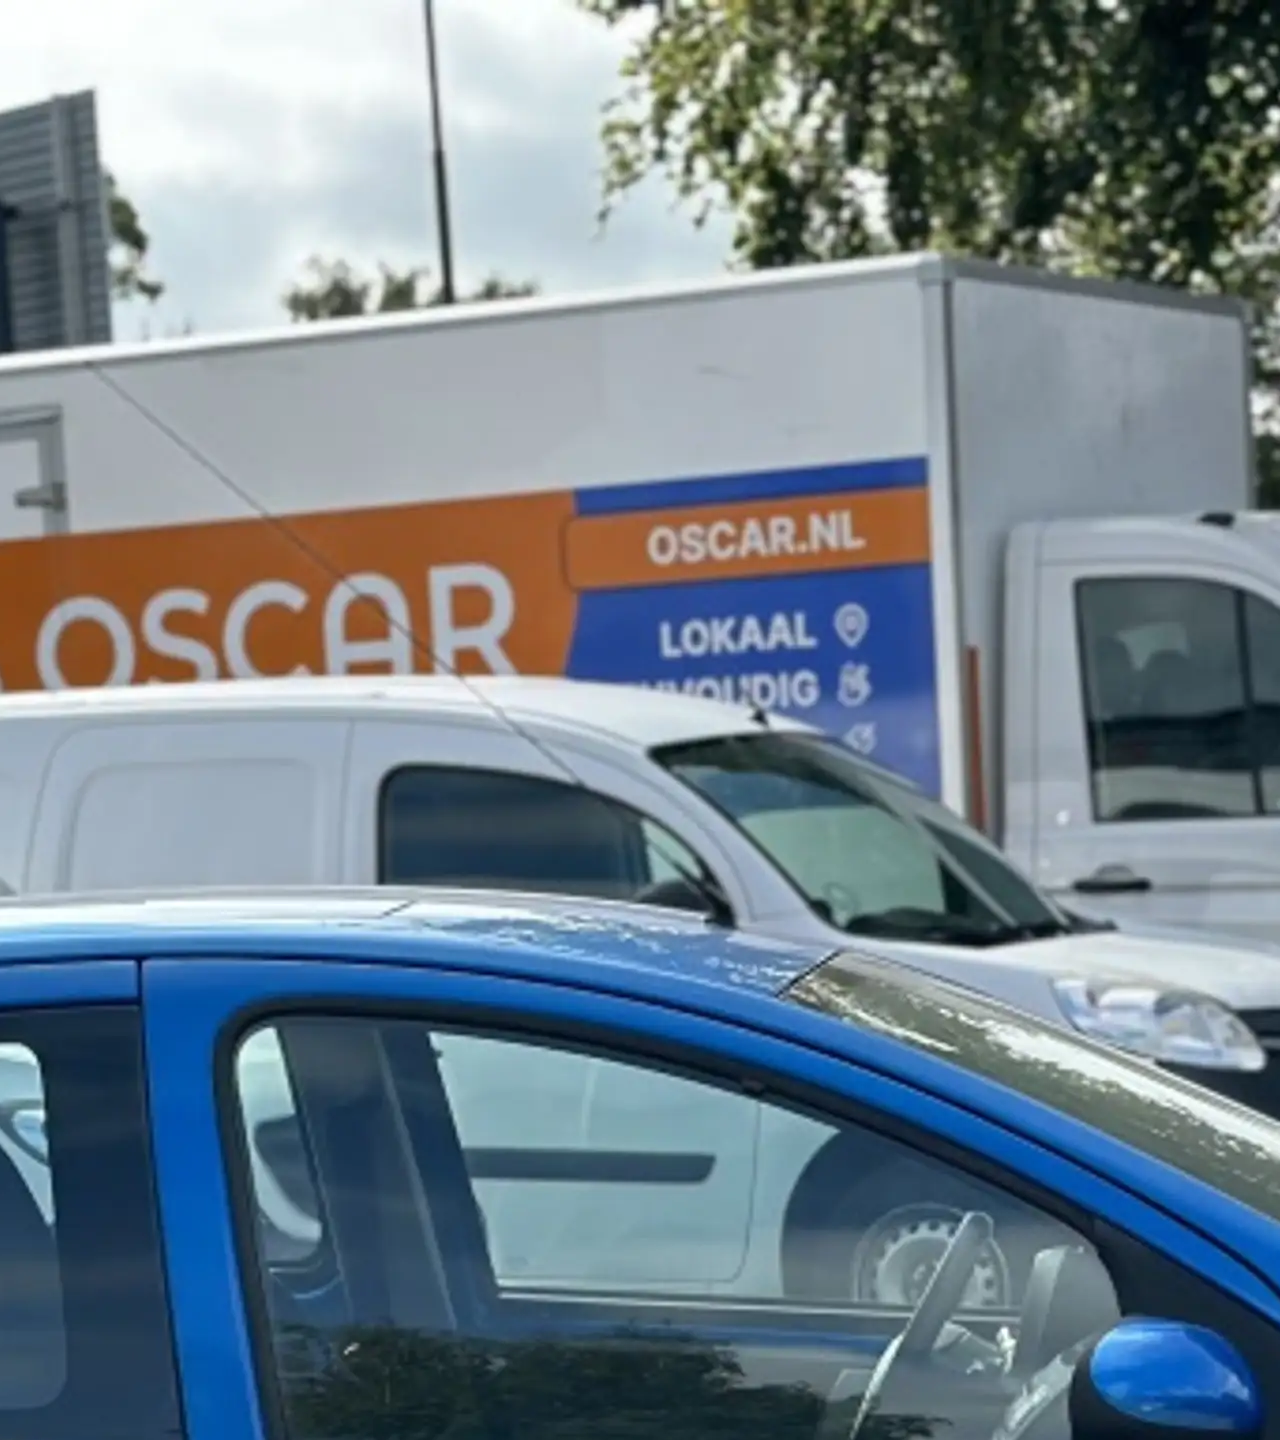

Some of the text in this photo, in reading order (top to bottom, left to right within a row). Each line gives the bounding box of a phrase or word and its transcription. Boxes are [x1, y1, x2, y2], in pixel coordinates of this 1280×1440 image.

[647, 508, 867, 564] OSCAR.NL
[36, 562, 521, 692] OSCAR
[659, 610, 818, 659] LOKAAL
